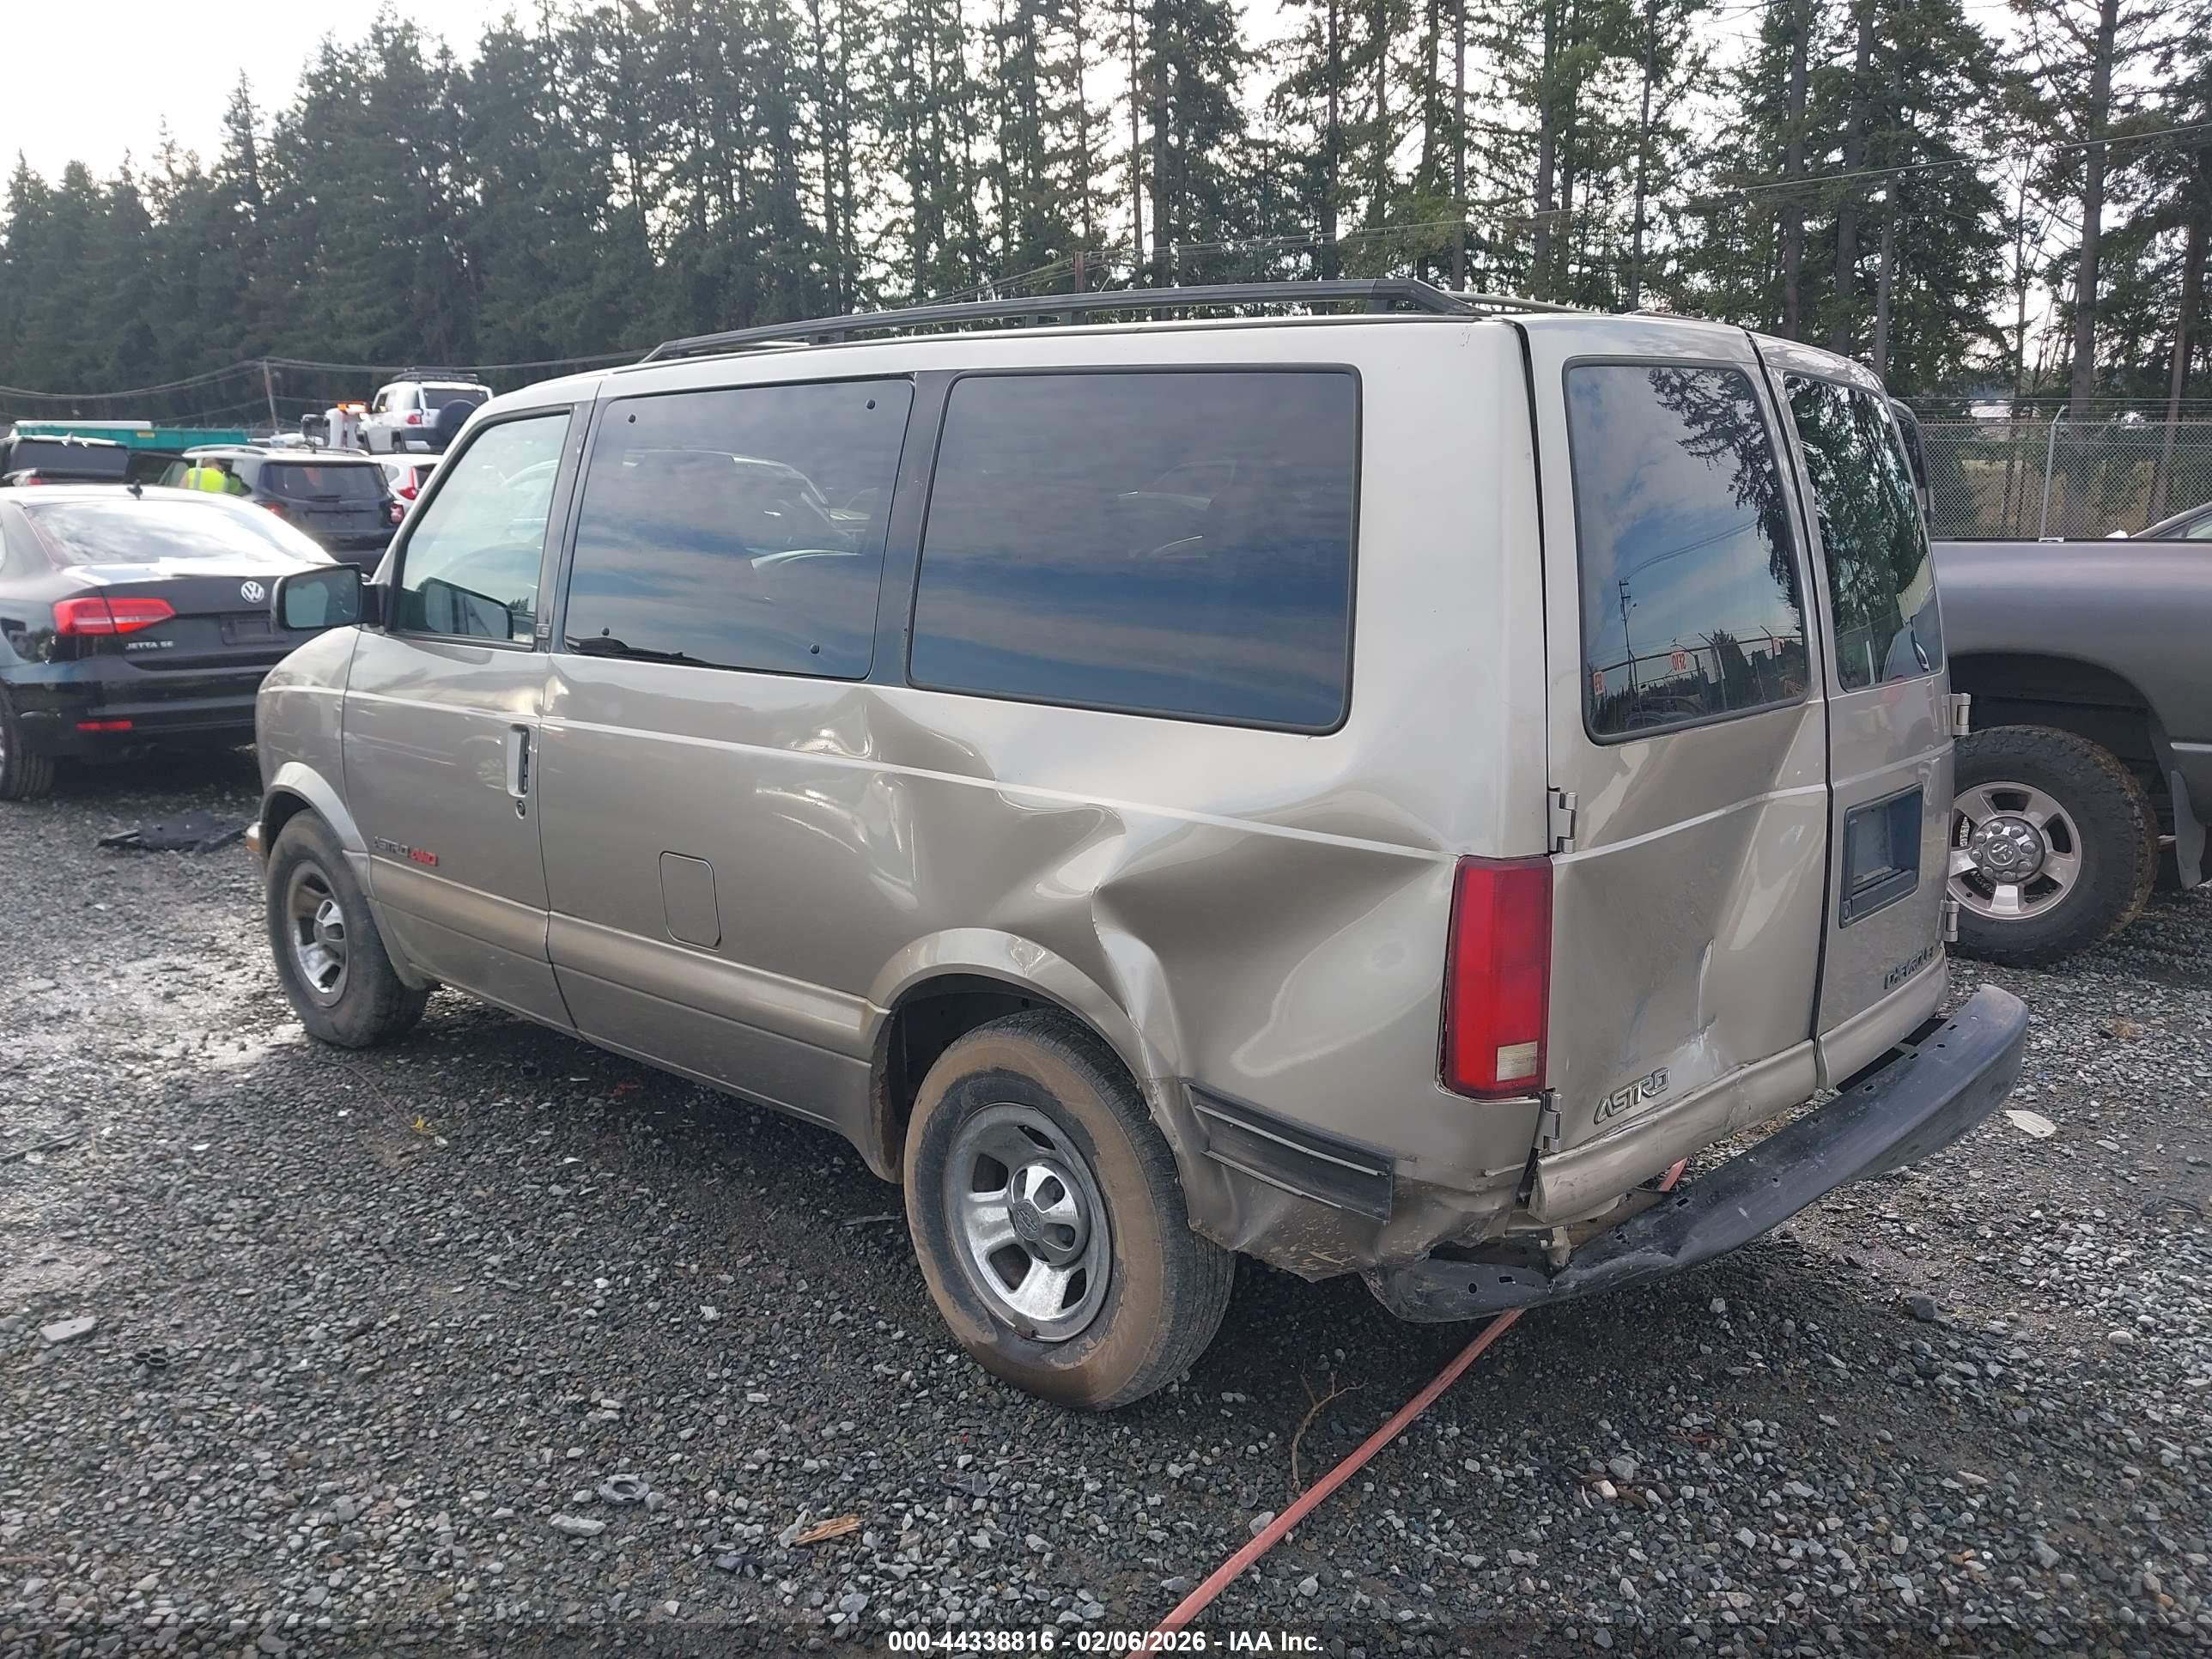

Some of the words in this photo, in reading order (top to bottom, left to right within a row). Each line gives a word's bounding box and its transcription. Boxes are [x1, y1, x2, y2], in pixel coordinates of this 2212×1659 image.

[240, 580, 264, 603] VW
[125, 641, 158, 651] JETTA
[373, 836, 410, 858] ASTRO
[1594, 1066, 1670, 1126] ASTRO
